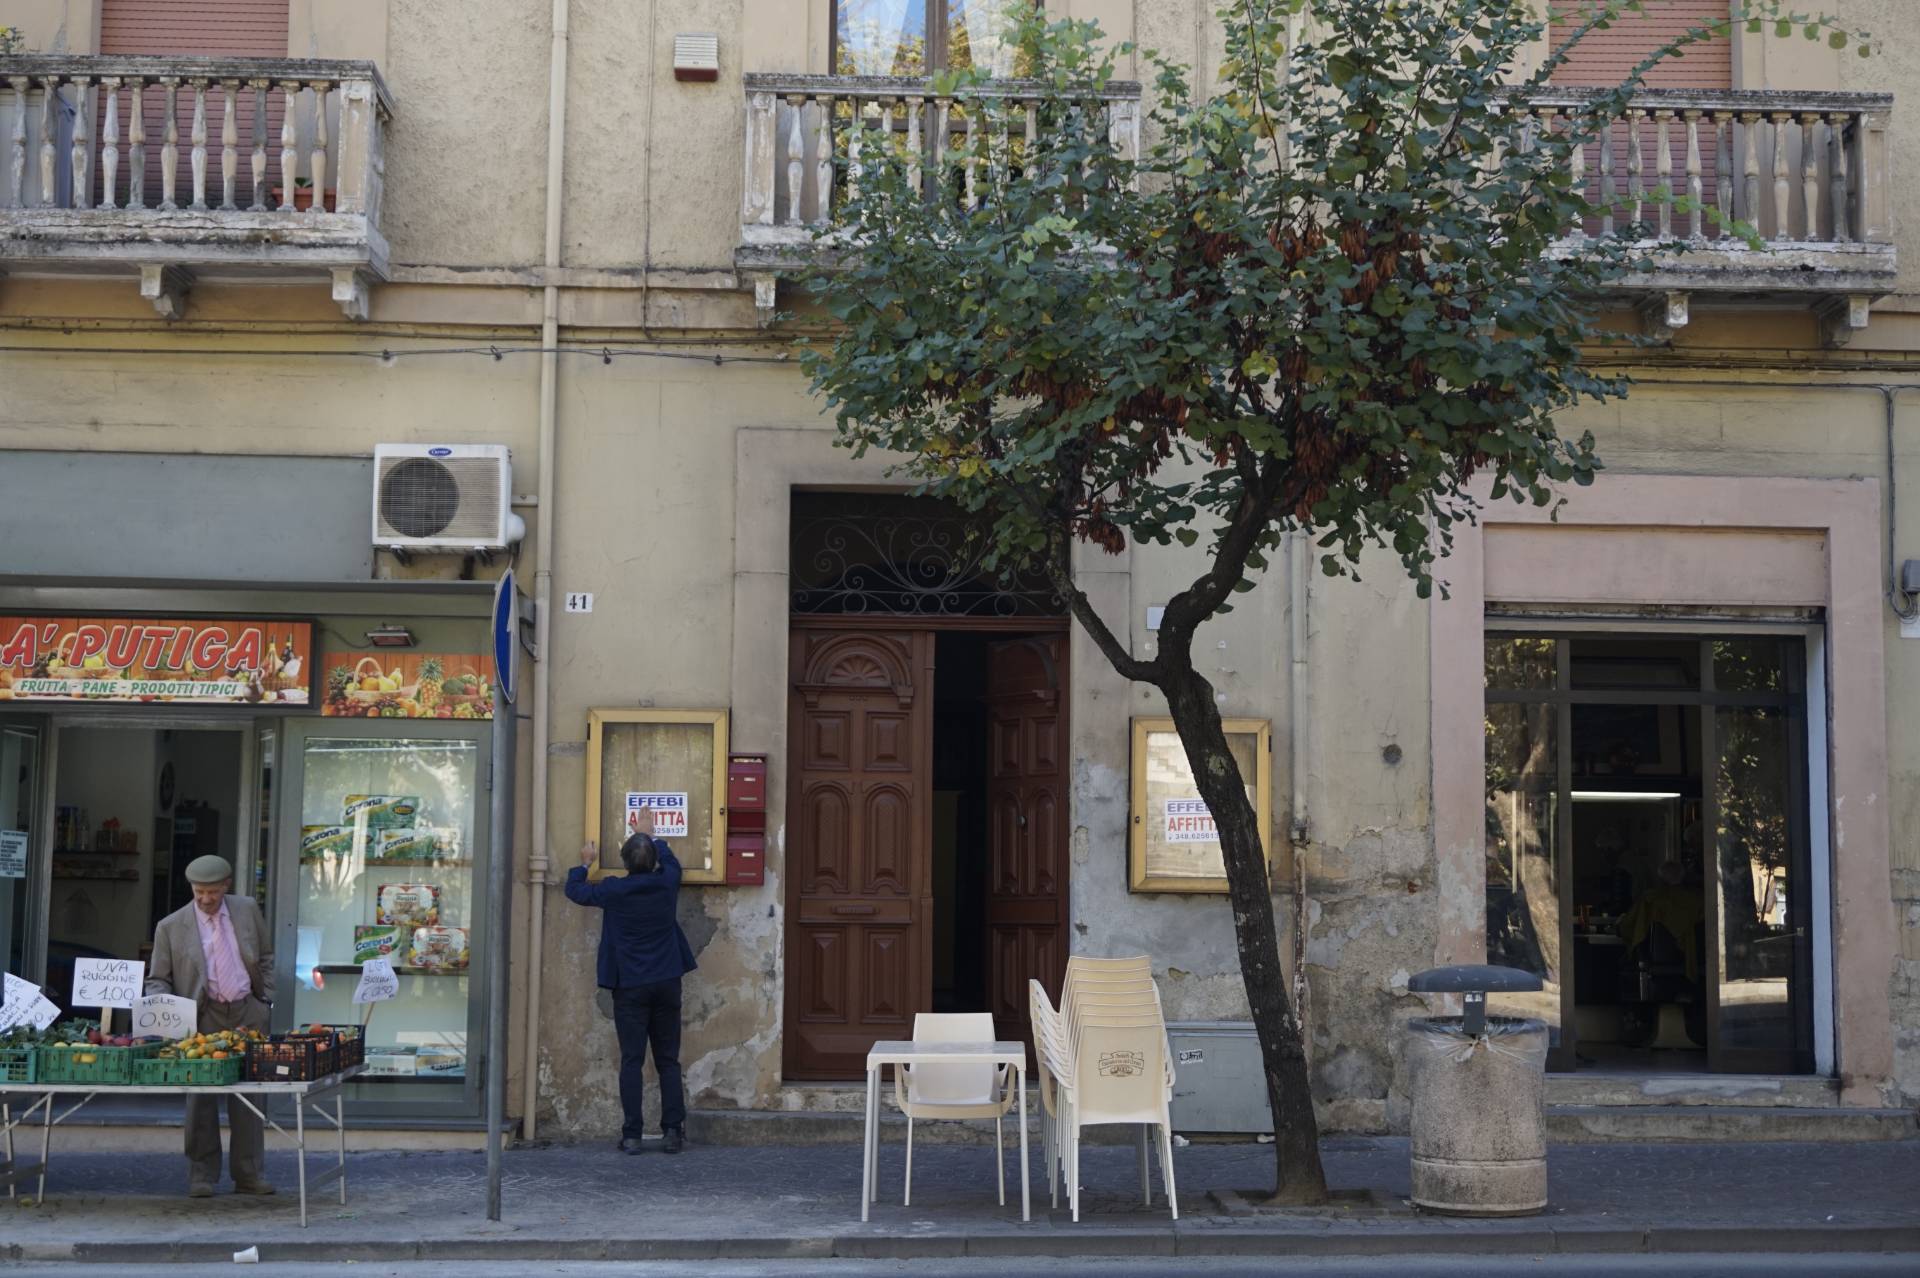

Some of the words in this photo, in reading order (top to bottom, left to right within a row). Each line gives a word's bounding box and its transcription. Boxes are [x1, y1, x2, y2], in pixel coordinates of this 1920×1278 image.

[569, 594, 587, 609] 41
[67, 624, 263, 672] PUTIGA
[20, 680, 68, 692] FRUTTA
[81, 681, 118, 693] PANE
[130, 682, 194, 694] PRODOTTI
[199, 683, 238, 695] TIPICI
[345, 797, 383, 816] Corona
[628, 796, 684, 807] EFFEBI
[1167, 802, 1210, 812] EFFE
[628, 811, 685, 826] AITTA
[1168, 816, 1219, 831] AFFITT
[303, 827, 341, 847] Corona
[384, 835, 415, 851] Corona
[355, 936, 393, 952] Corona
[96, 961, 129, 972] UVA
[79, 984, 93, 1001] €
[143, 997, 177, 1007] MELE
[139, 1011, 182, 1028] 0,99
